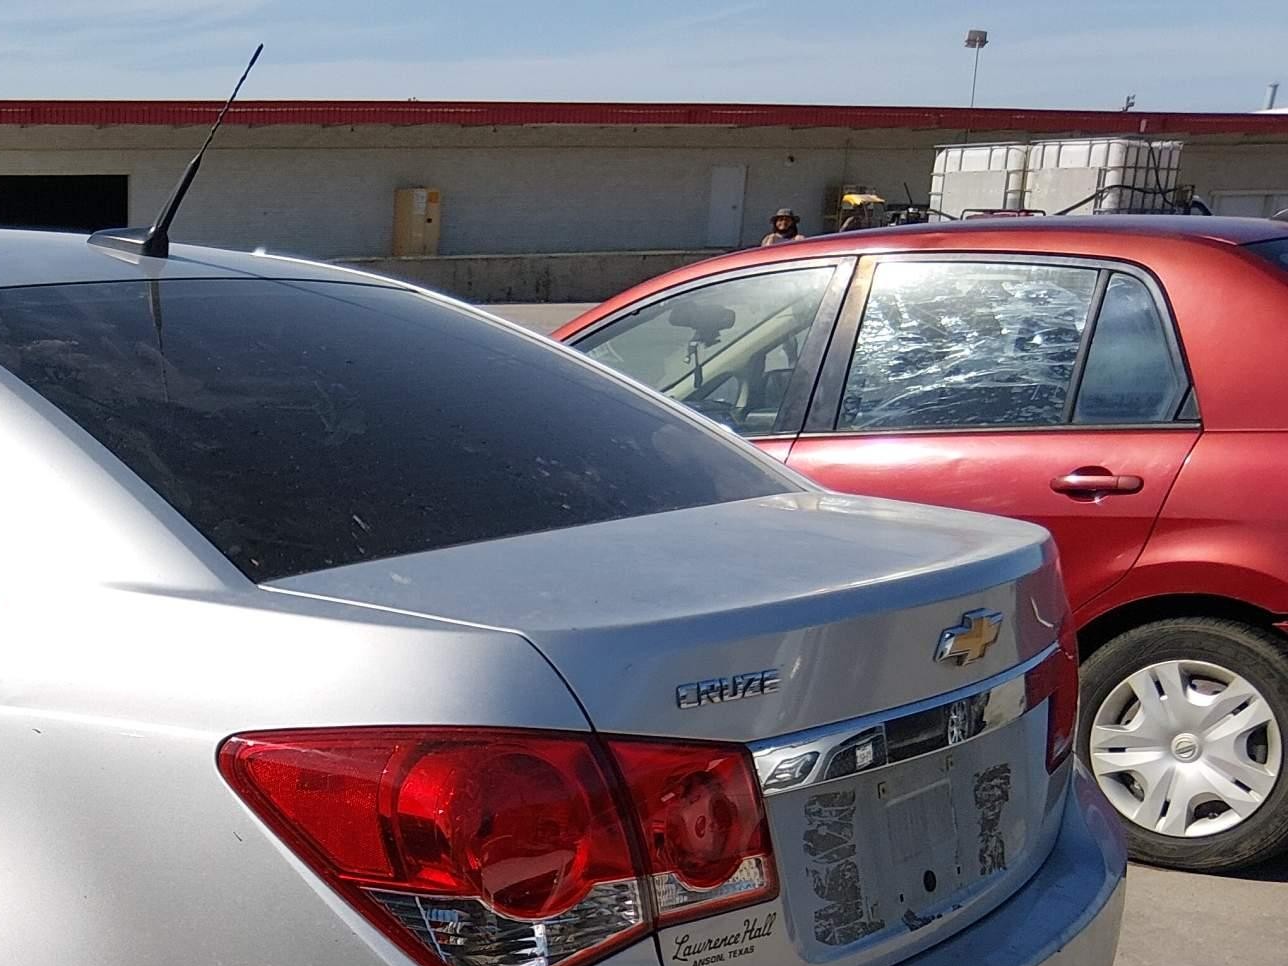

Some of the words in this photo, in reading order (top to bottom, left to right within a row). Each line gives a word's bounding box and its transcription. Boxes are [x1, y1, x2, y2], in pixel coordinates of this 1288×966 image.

[676, 668, 781, 709] CRUZE
[672, 934, 741, 961] Lawrence
[741, 912, 777, 943] Hall
[728, 946, 755, 959] TEXAS
